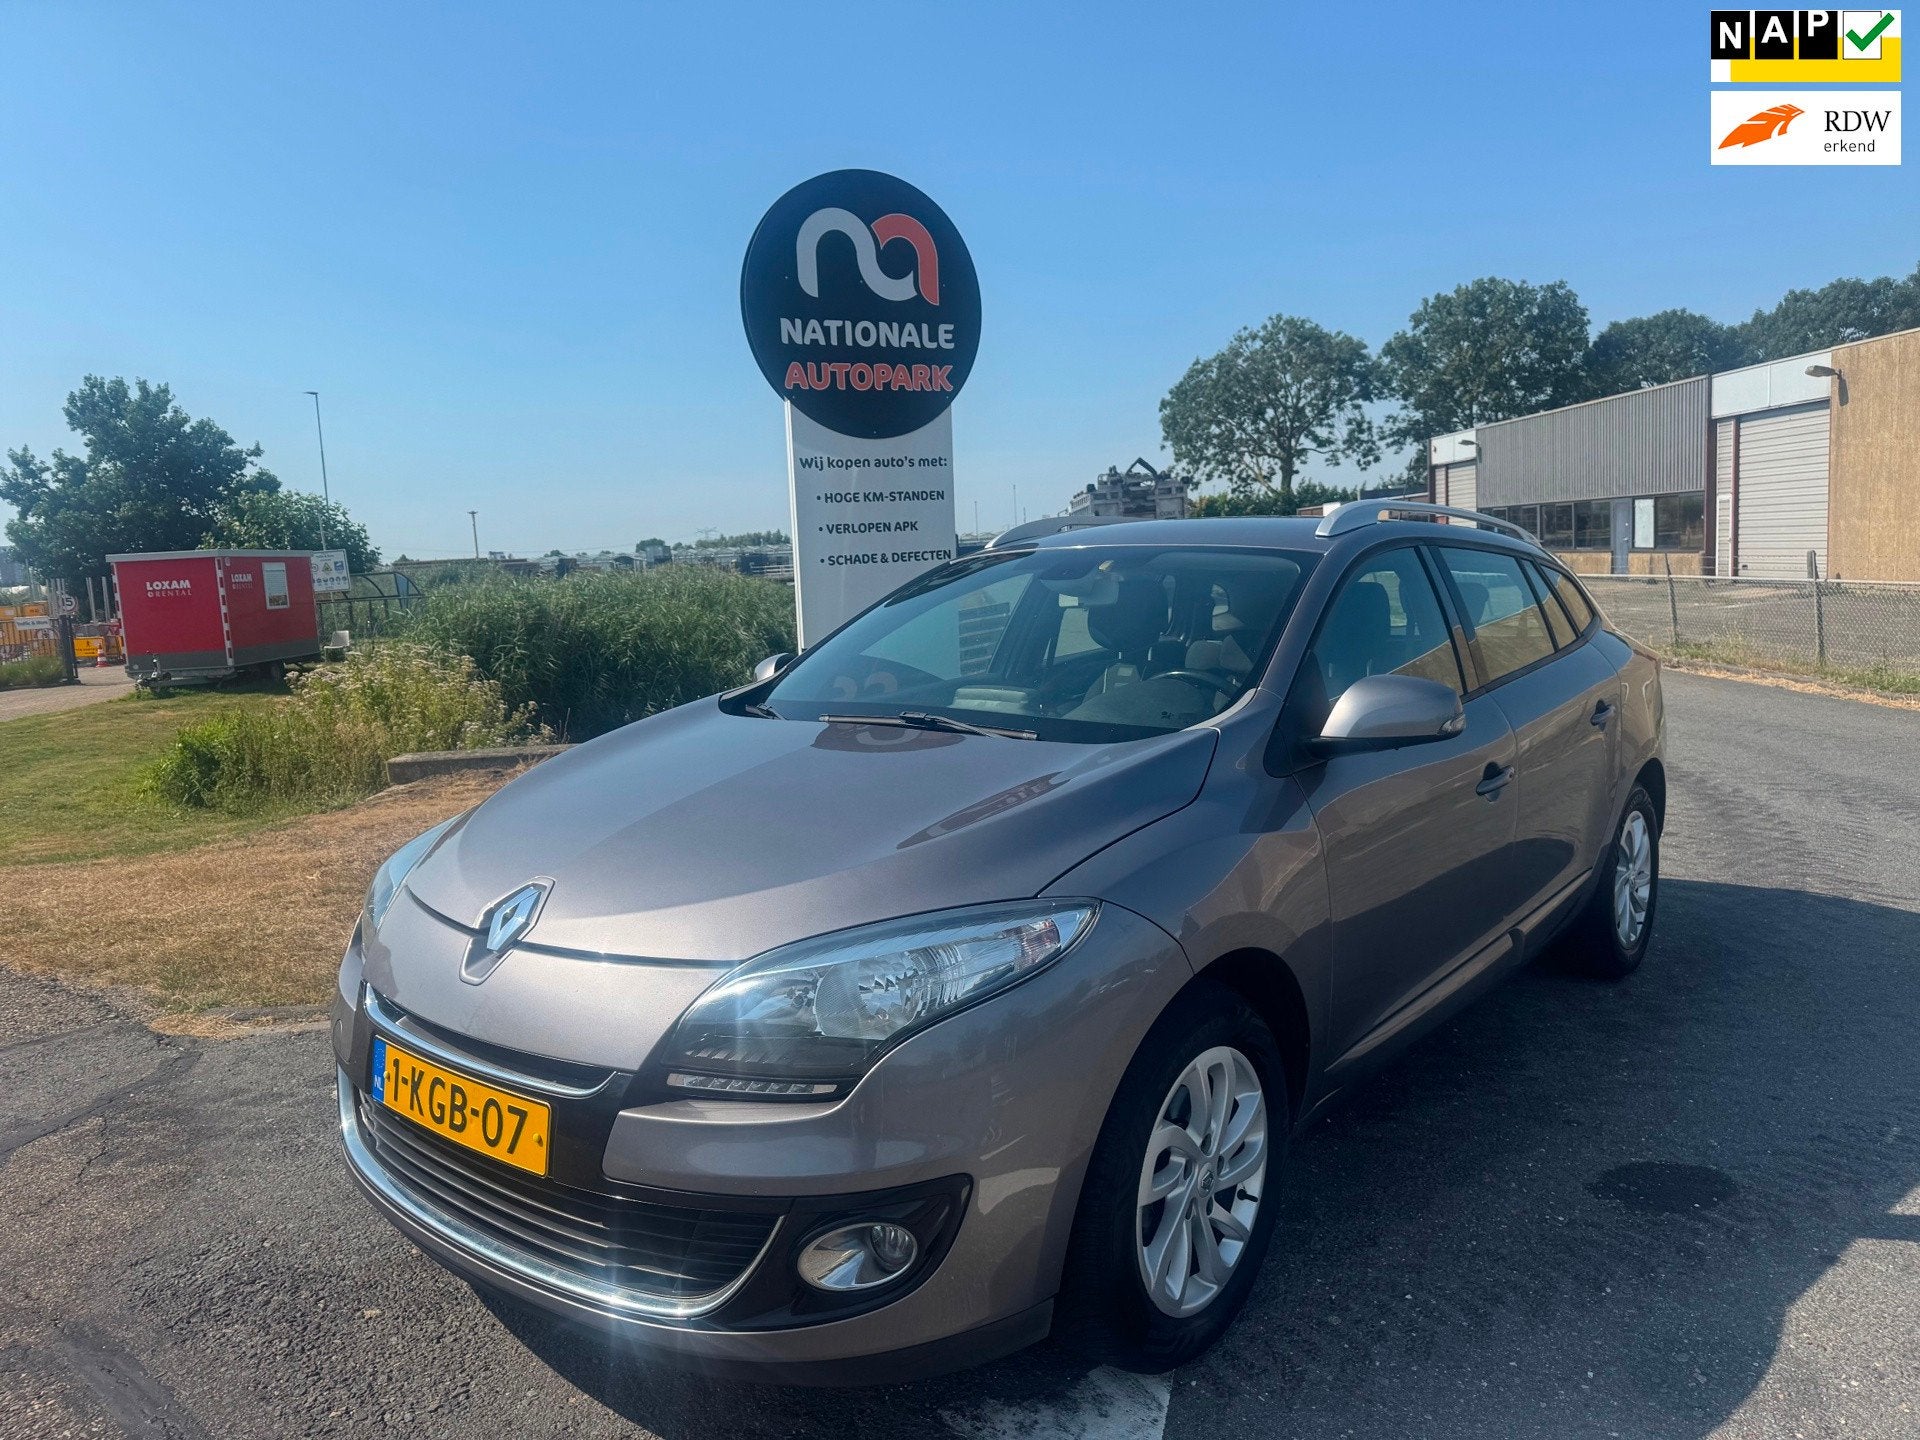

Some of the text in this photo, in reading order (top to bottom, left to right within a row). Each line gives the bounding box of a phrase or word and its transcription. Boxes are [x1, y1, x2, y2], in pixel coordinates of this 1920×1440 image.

[780, 317, 954, 350] NATIONALE
[785, 361, 953, 391] AUTOPARK
[800, 455, 948, 471] Wij kopen auto's met:
[825, 490, 944, 503] HOGE KM-STANDEN
[826, 521, 918, 535] VERLOPEN APK
[828, 549, 951, 566] SCHADE & DEFECTEN
[146, 580, 191, 590] LOXAM
[374, 1074, 384, 1091] NL
[392, 1058, 528, 1155] 1-KGB-07
